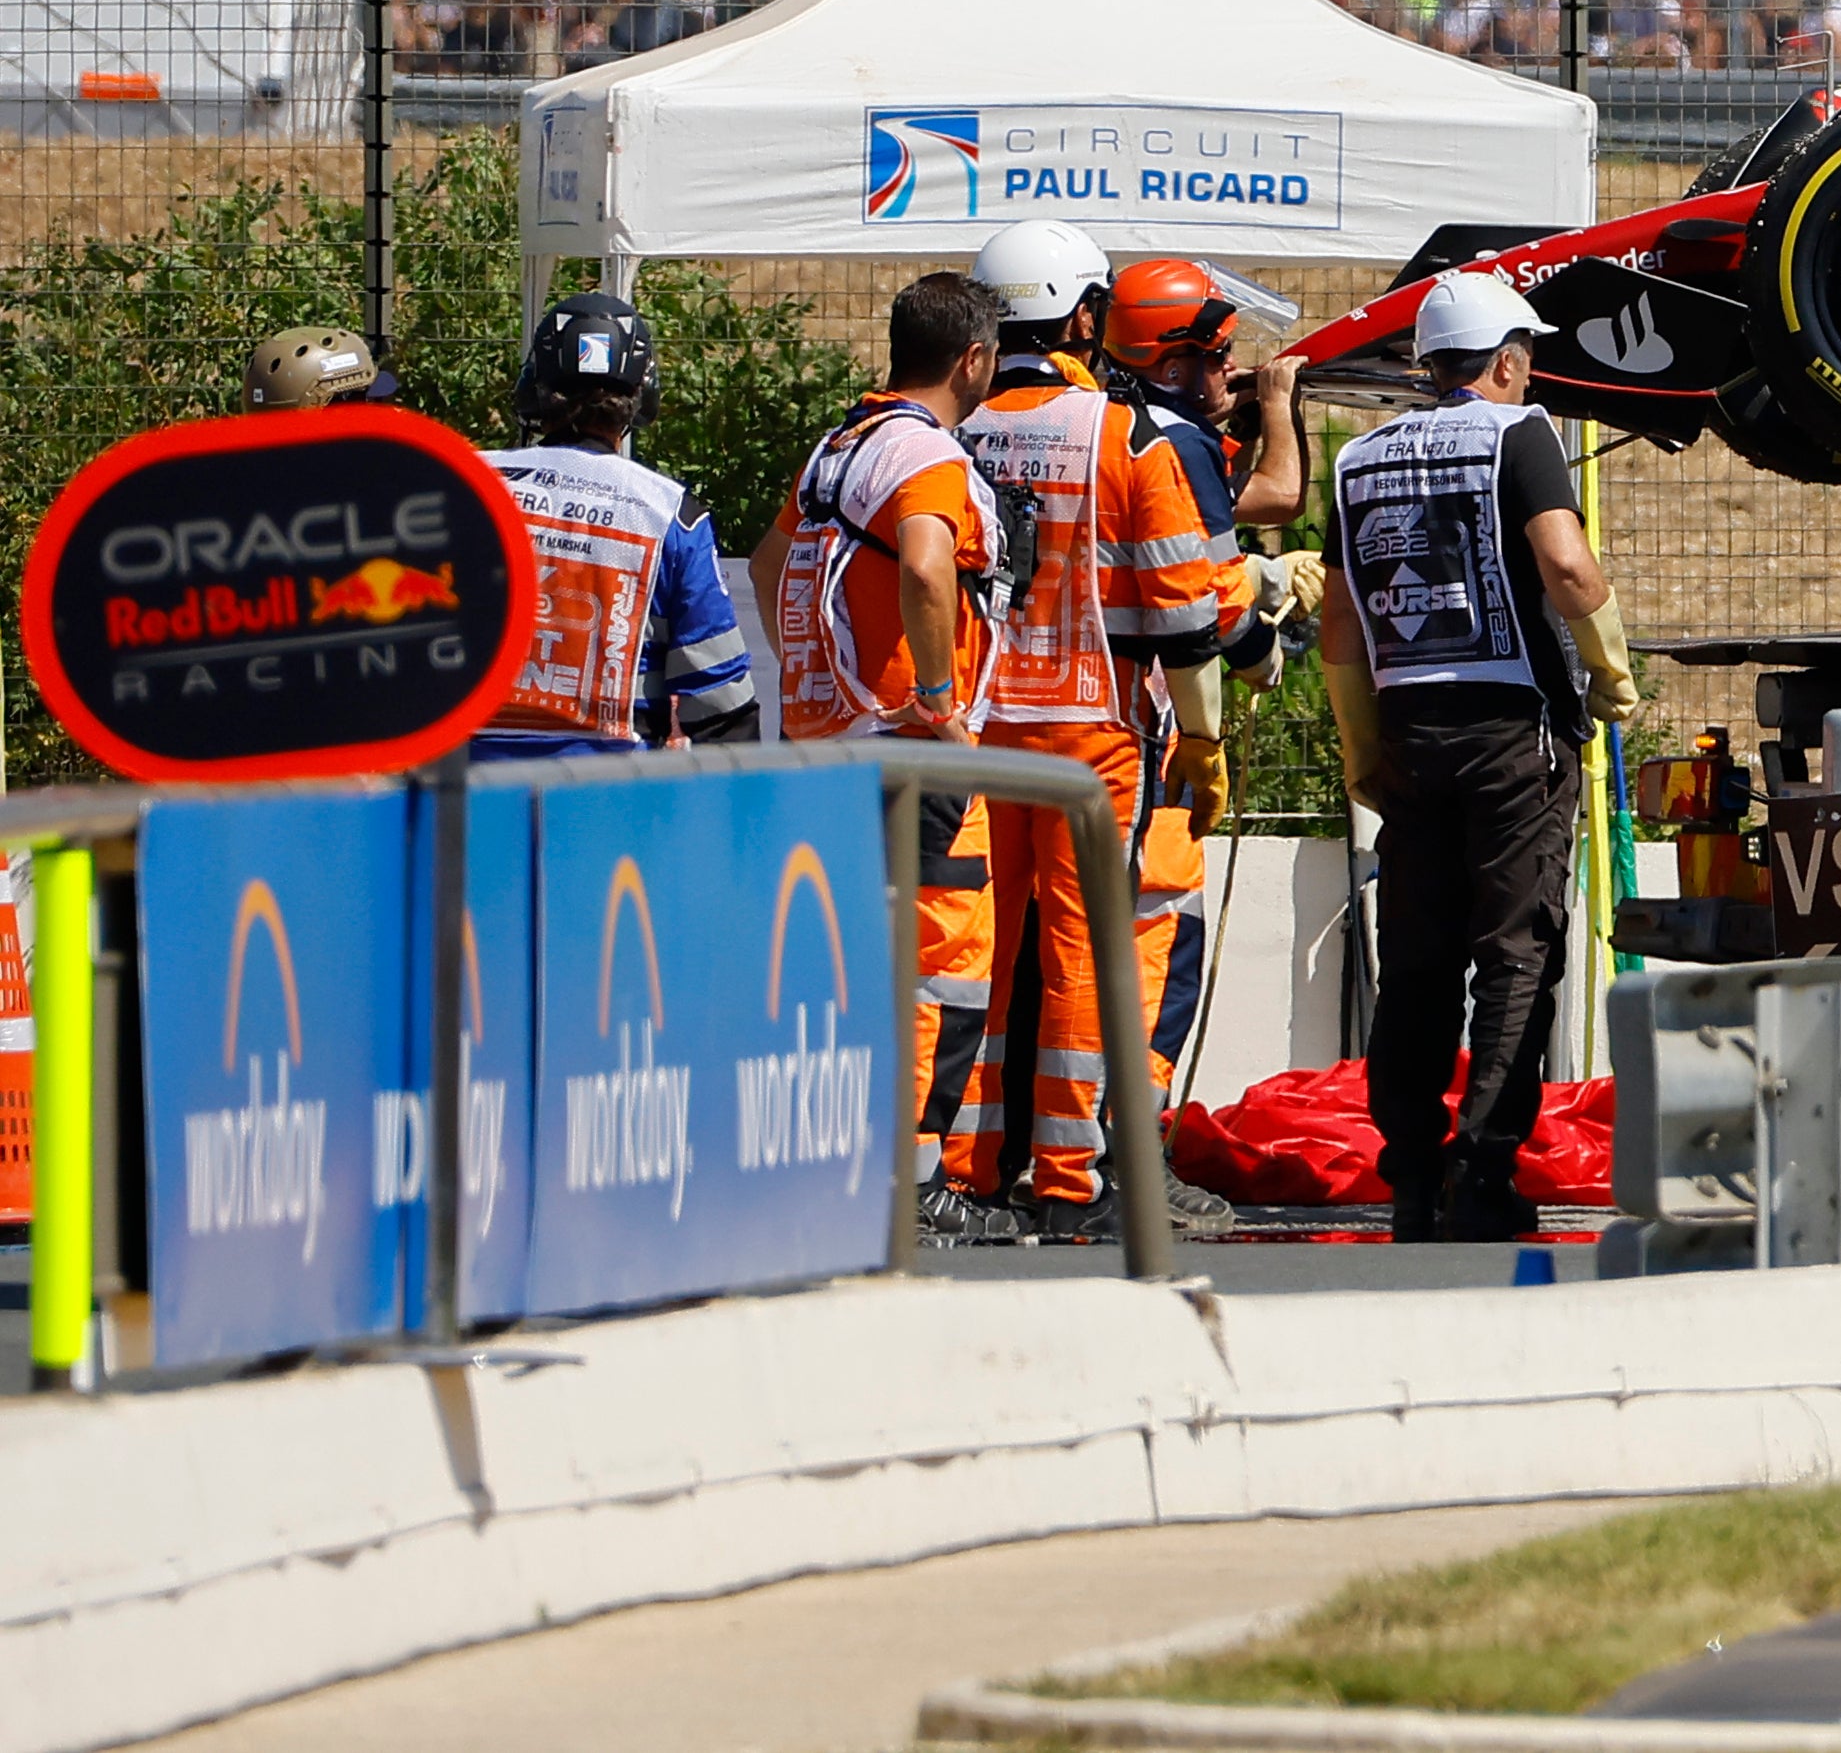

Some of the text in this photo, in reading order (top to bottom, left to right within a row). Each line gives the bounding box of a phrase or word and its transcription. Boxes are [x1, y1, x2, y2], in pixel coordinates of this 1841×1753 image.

[1005, 128, 1309, 159] CIRCUIT
[1005, 167, 1309, 205] PAUL RICARD
[1385, 440, 1416, 458] FRA
[535, 471, 557, 486] FIA
[984, 460, 1067, 481] RA 2017
[562, 501, 614, 526] 2008
[101, 491, 450, 583] ORACLE
[546, 535, 593, 555] MARSHAL
[1473, 493, 1505, 610] FRANCE
[600, 574, 638, 700] FRANCE
[112, 635, 466, 703] RACING
